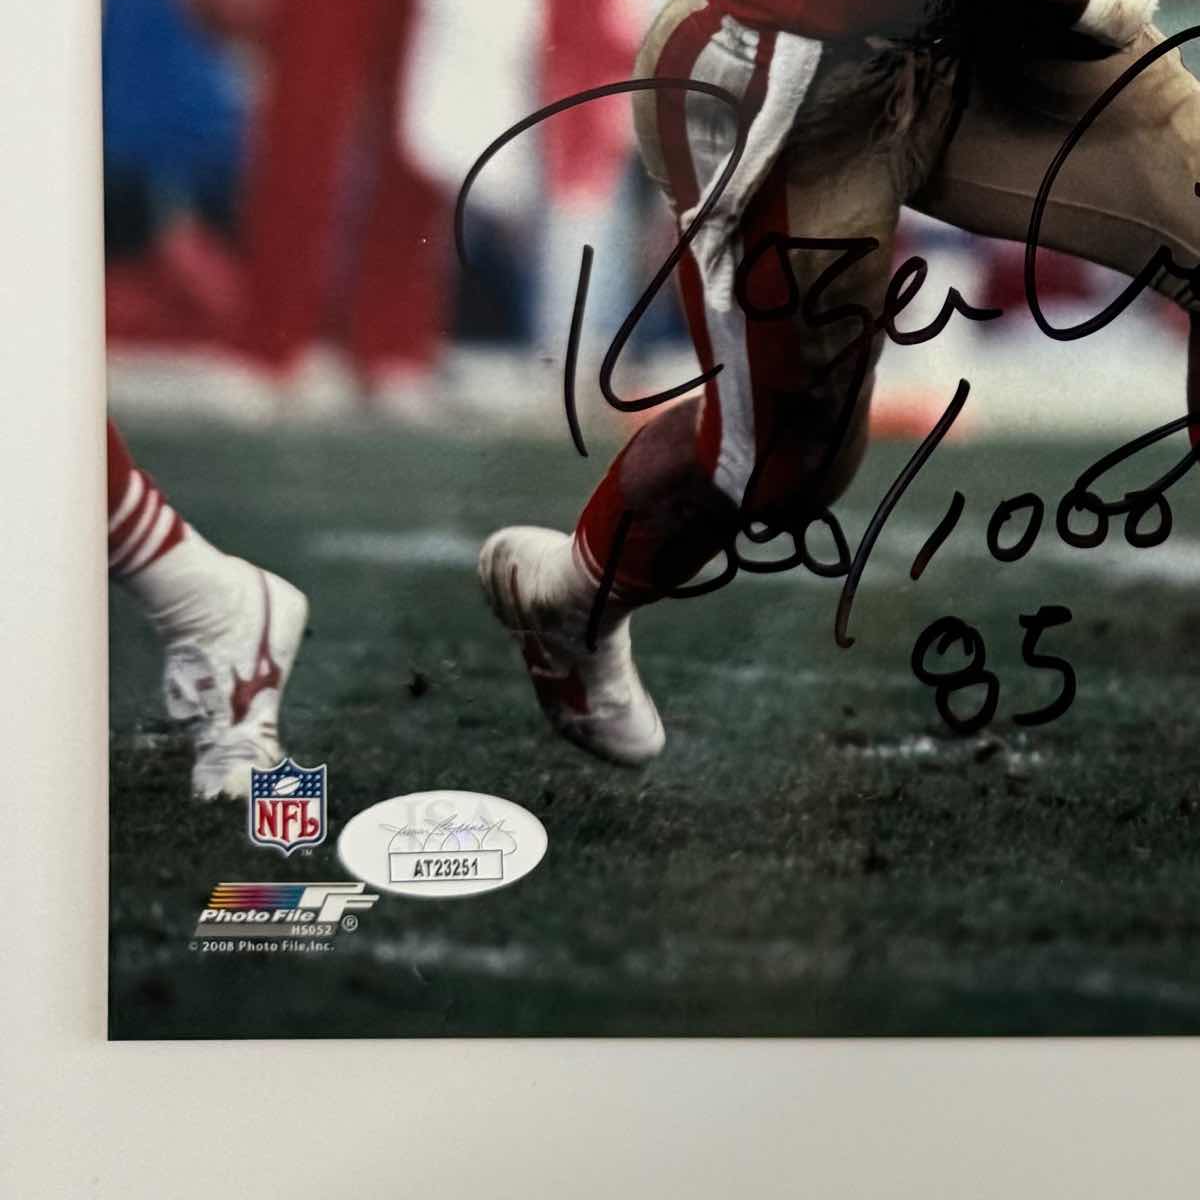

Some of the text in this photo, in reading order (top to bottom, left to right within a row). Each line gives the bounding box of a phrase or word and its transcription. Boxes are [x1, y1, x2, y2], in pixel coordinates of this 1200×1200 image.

[912, 605, 1077, 733] 85
[257, 800, 320, 842] NFL
[414, 858, 479, 877] AT23251
[199, 909, 316, 922] Photo File
[203, 941, 234, 951] 2008
[238, 941, 277, 951] Photo
